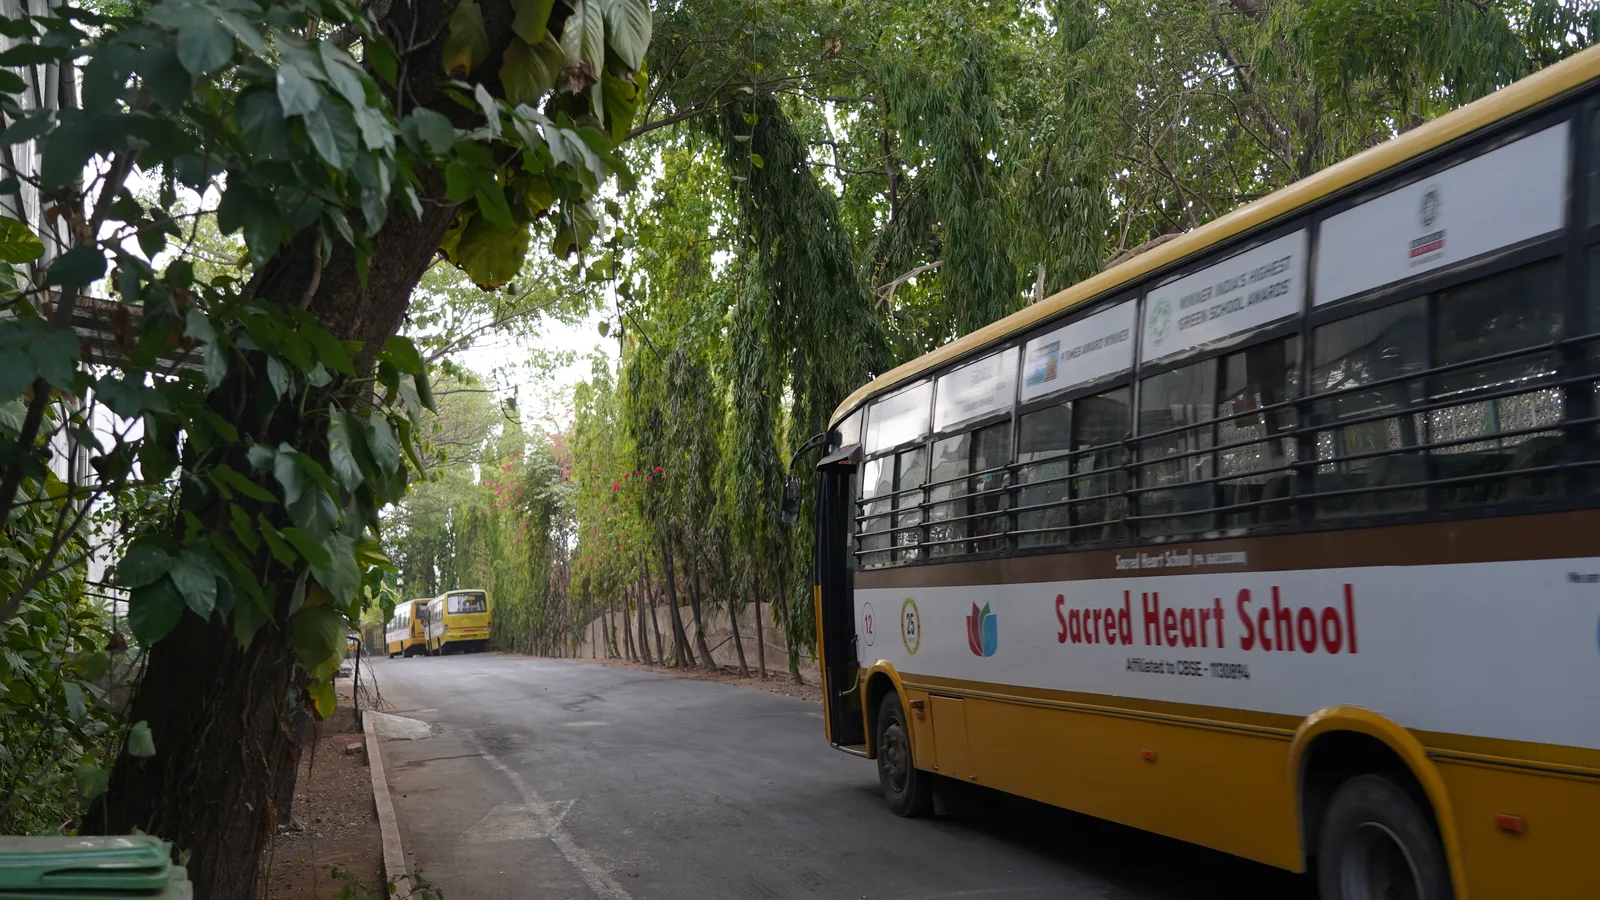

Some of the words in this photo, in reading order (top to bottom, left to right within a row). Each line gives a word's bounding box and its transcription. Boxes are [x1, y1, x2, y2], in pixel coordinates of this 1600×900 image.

[1249, 254, 1293, 284] HIGHEST
[1209, 295, 1245, 321] SCHOOL
[1115, 552, 1140, 570] Sacred
[1140, 552, 1164, 568] Heart
[1164, 548, 1192, 567] School
[864, 614, 873, 635] 12
[906, 612, 915, 635] 25
[1055, 589, 1133, 645] Sacred
[1141, 591, 1226, 649] Heart
[1236, 583, 1359, 655] School
[1125, 656, 1165, 674] Affiliated
[1165, 660, 1176, 675] to
[1176, 659, 1203, 677] CBSE
